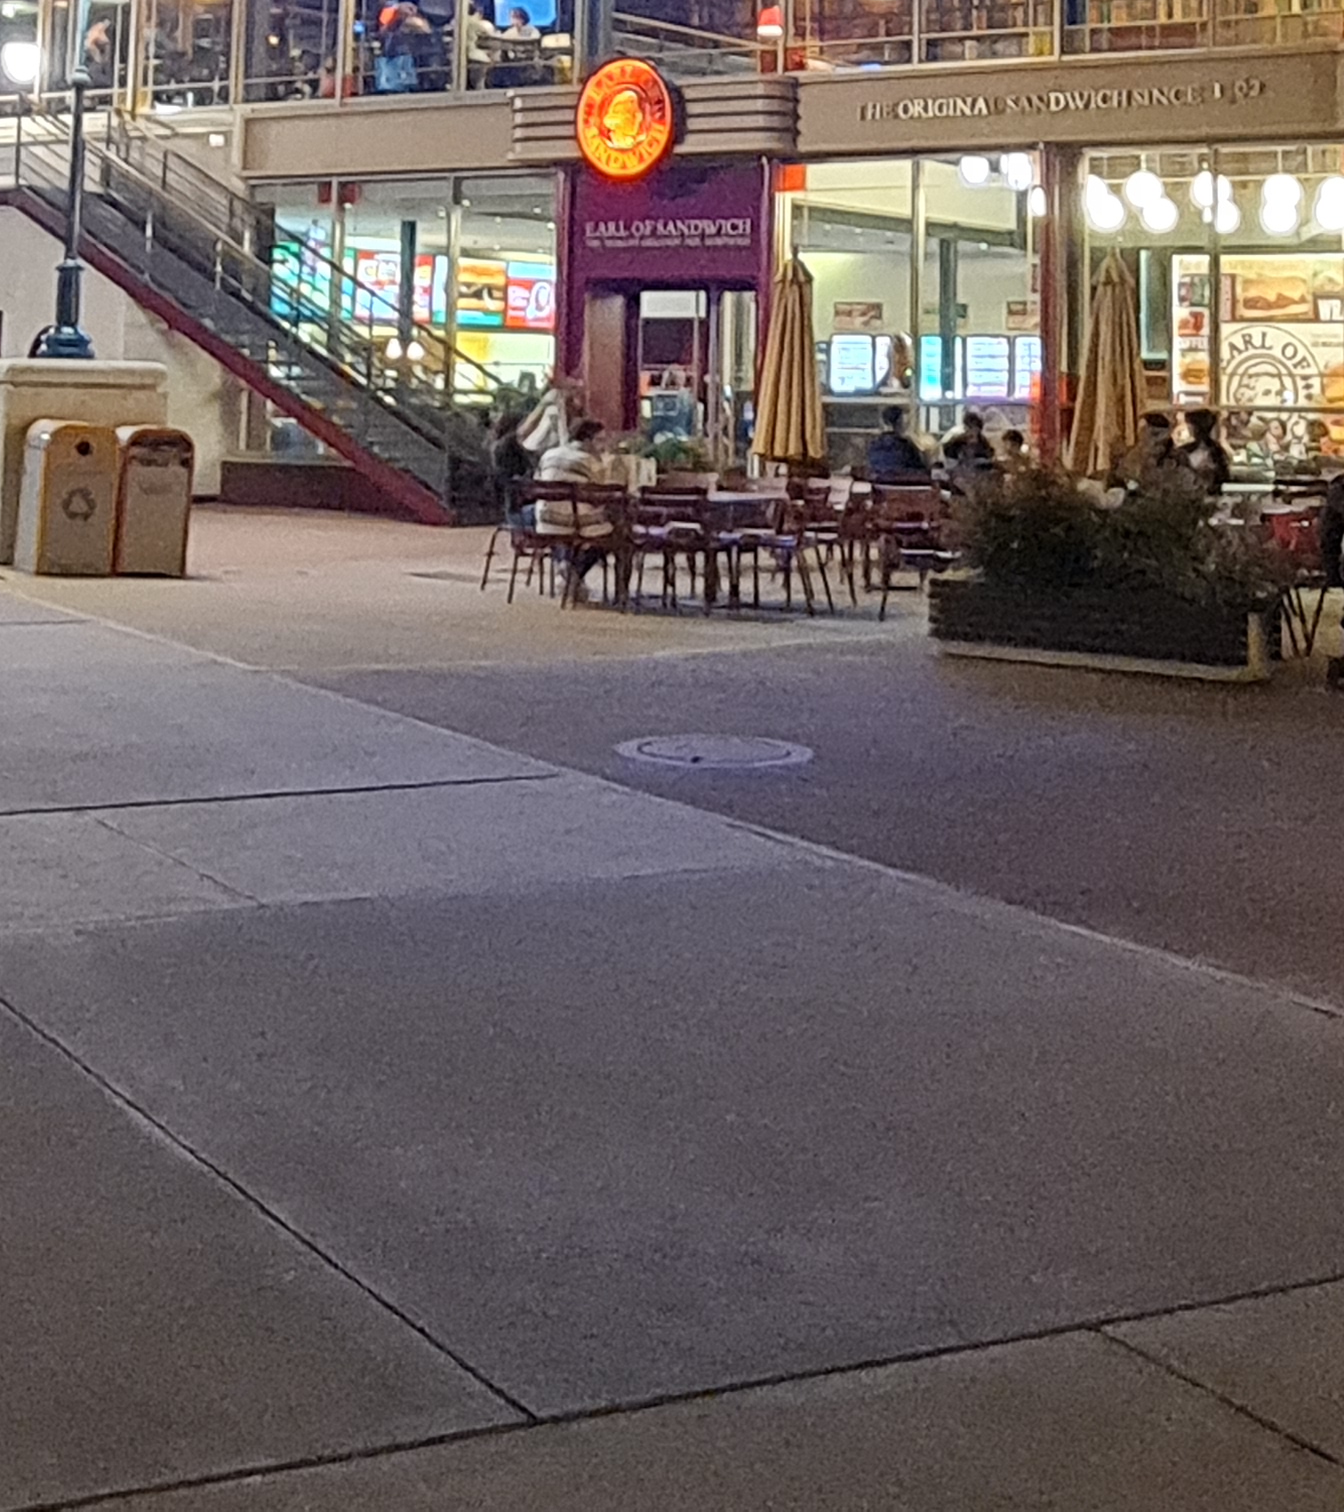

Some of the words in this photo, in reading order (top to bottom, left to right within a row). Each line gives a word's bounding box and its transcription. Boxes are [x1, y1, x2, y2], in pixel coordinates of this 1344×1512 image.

[585, 221, 629, 237] EARL
[631, 220, 656, 237] OF
[657, 218, 752, 236] SANDWICH
[1281, 342, 1313, 371] OF
